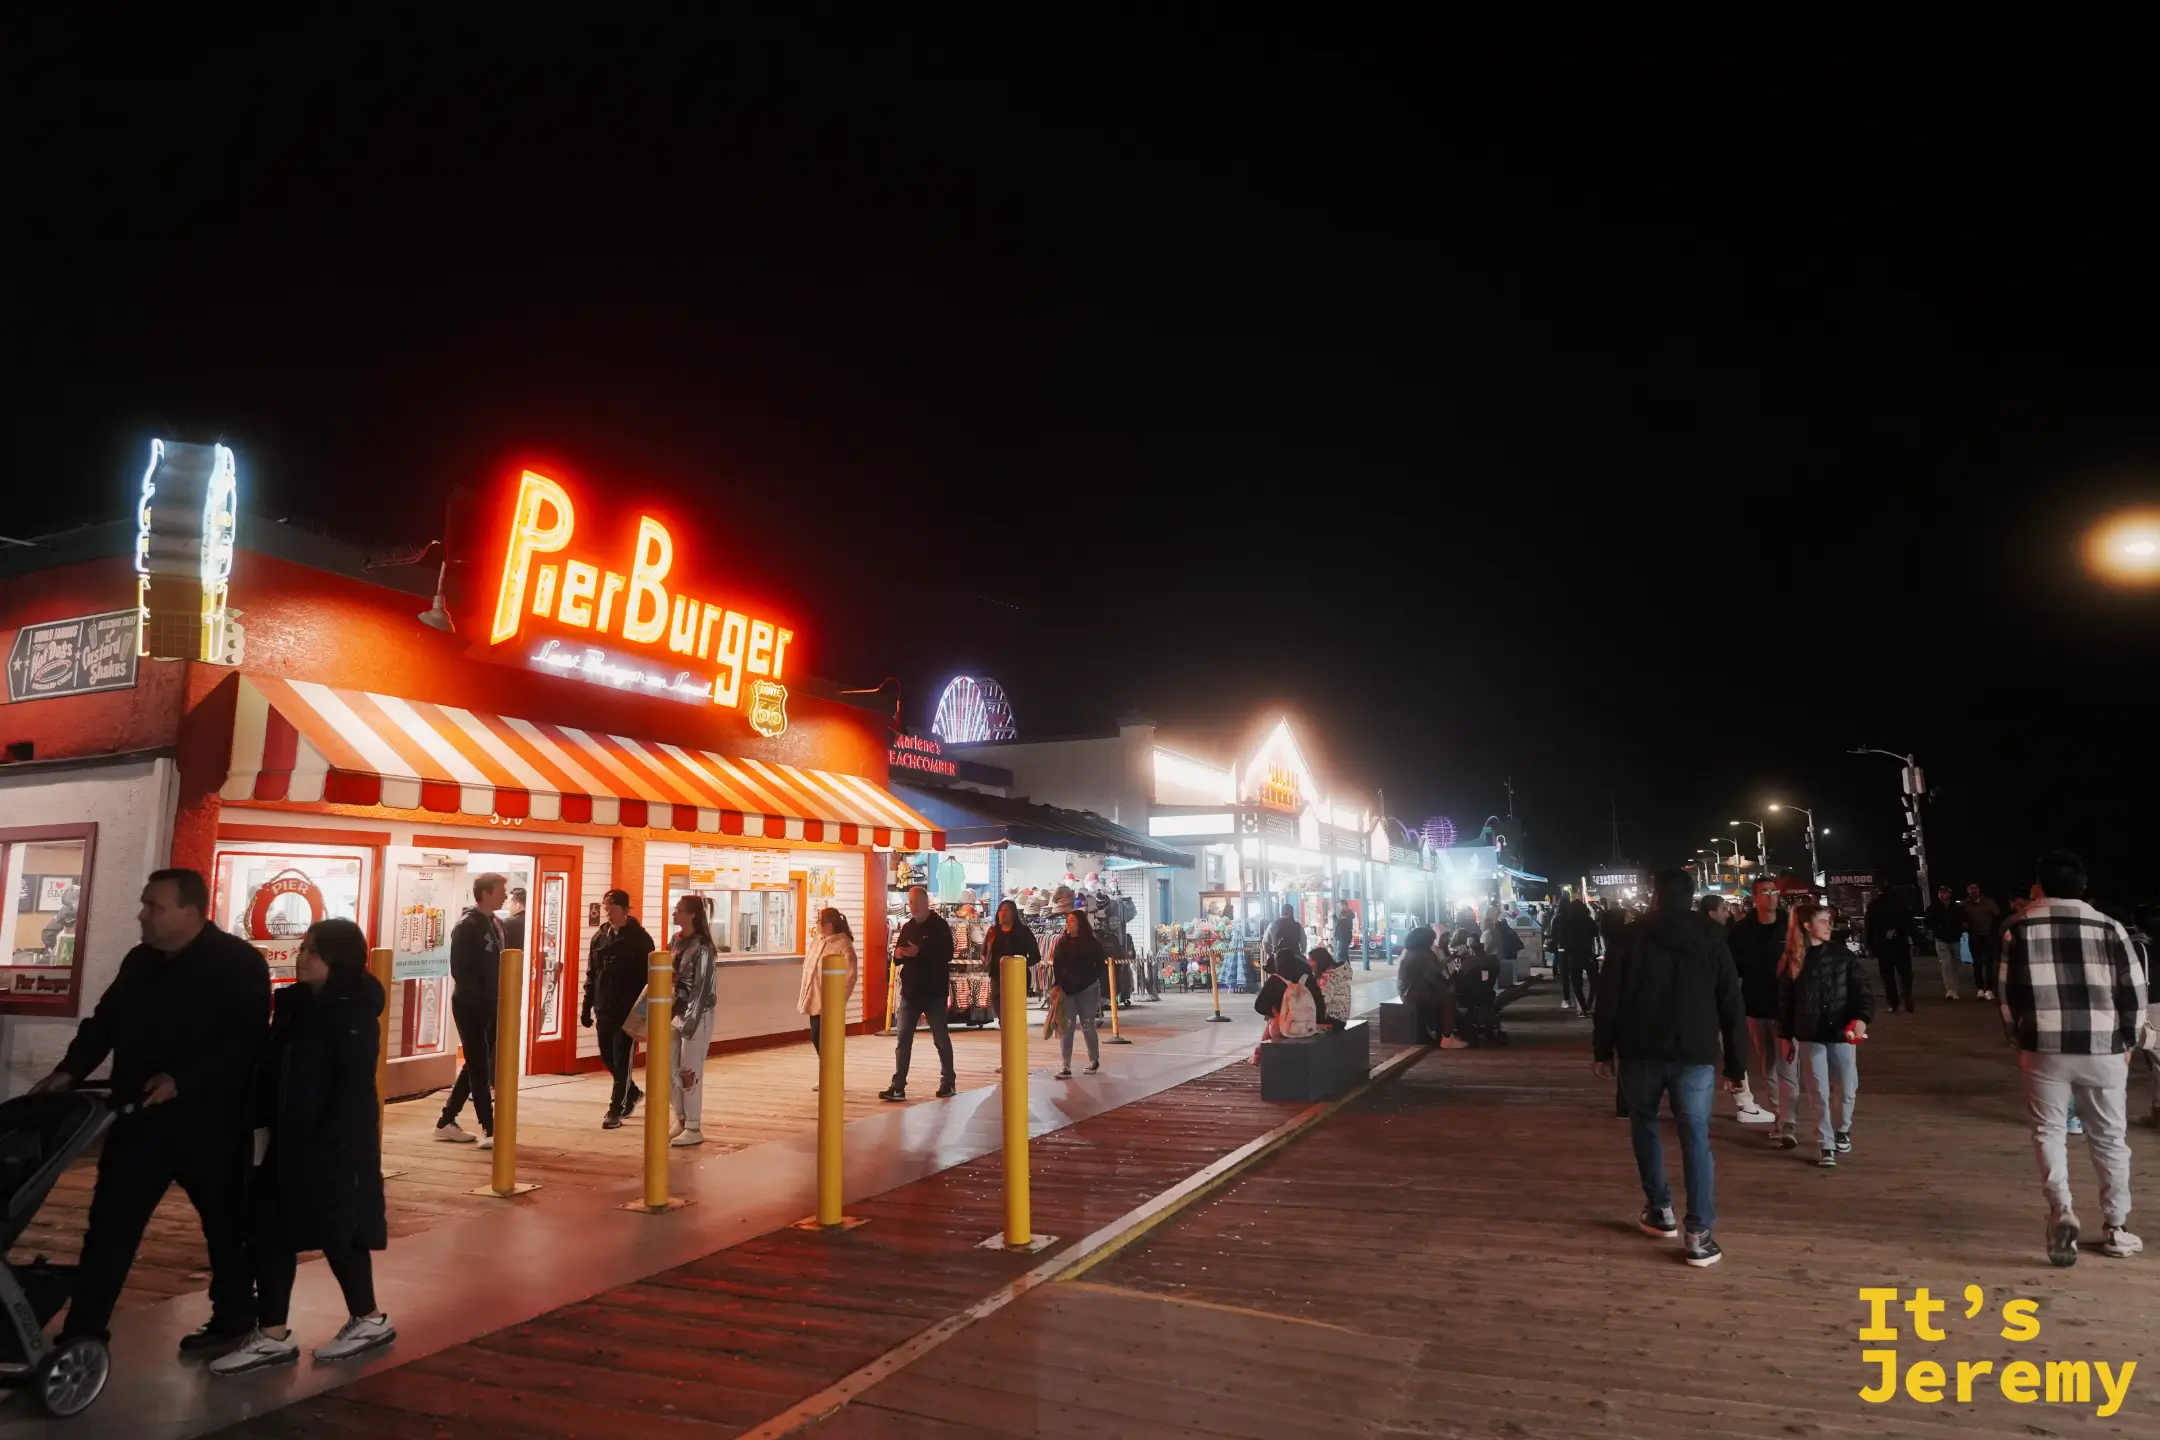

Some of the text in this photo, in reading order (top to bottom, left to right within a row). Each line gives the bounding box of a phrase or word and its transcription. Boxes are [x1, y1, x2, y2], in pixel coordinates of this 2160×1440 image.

[48, 640, 73, 660] Dogs
[82, 636, 121, 671] Custard
[89, 661, 127, 685] Shakes
[756, 700, 782, 727] 66
[893, 733, 942, 755] Marlene's
[888, 749, 957, 777] EACHCOMBER
[272, 880, 309, 894] PIER
